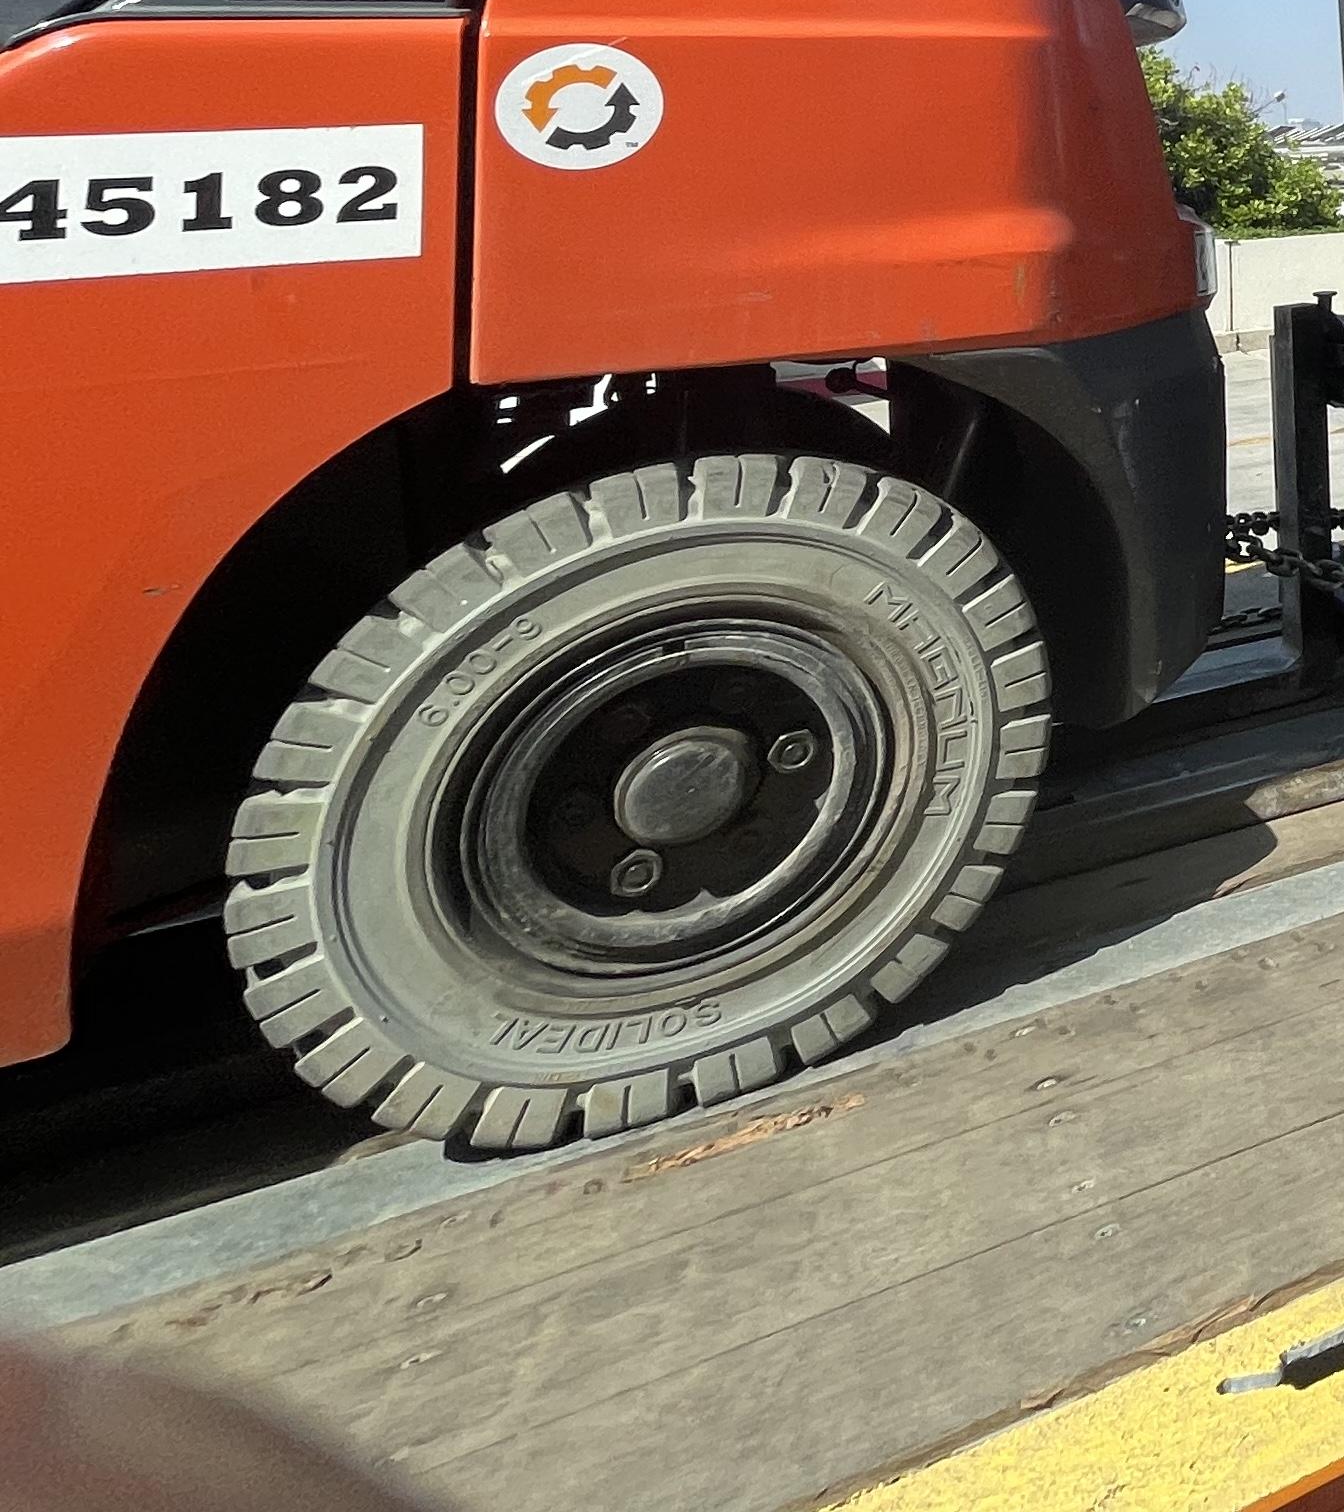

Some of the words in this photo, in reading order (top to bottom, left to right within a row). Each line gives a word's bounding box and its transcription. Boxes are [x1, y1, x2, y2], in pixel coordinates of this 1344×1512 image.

[0, 165, 398, 242] 45182
[418, 617, 543, 727] 6.00-9
[863, 581, 968, 816] MAGNUM
[489, 998, 722, 1055] SOLIDEAL
